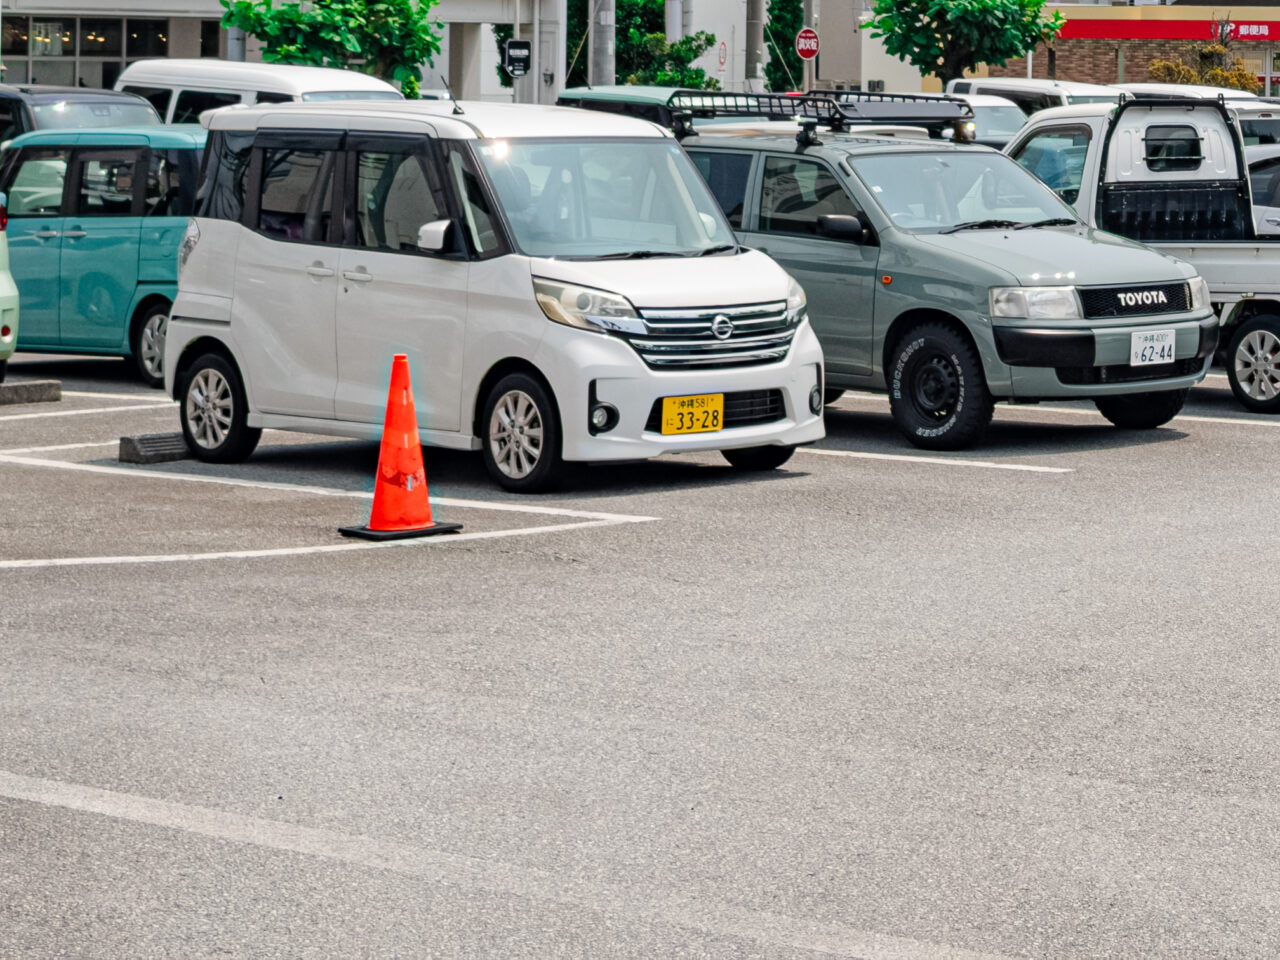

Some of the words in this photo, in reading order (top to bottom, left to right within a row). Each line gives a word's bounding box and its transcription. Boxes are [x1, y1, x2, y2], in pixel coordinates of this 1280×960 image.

[1239, 25, 1269, 36] 郵便局
[1117, 291, 1168, 307] TOYOTA
[1140, 343, 1173, 362] 62-44
[676, 409, 719, 431] 33-28
